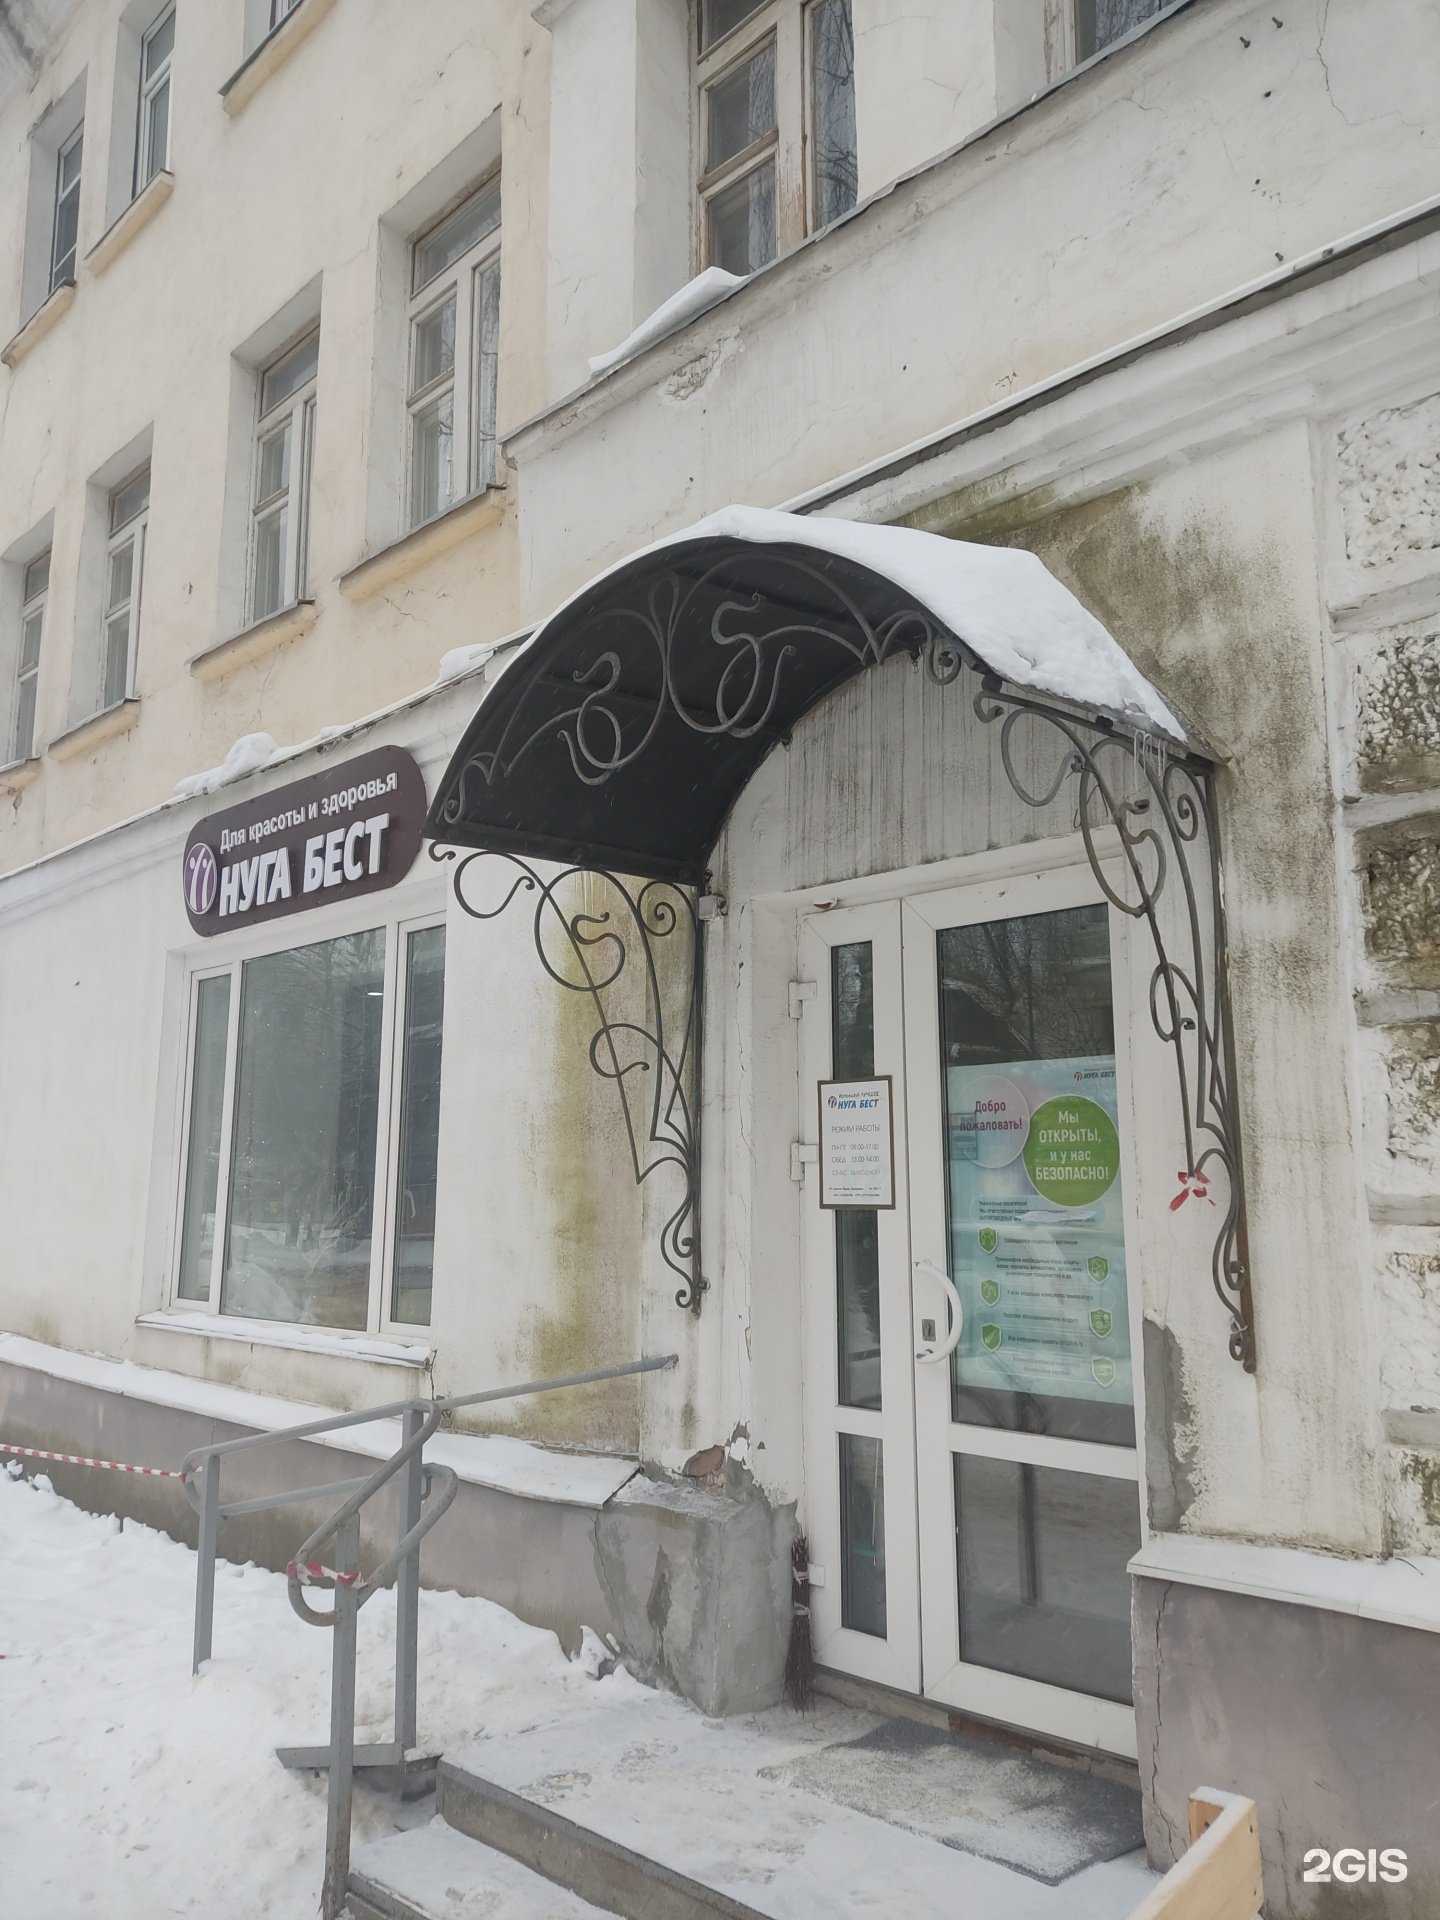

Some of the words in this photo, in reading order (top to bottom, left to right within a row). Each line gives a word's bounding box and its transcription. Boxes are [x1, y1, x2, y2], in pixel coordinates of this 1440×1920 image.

[219, 828, 246, 854] Для
[248, 806, 305, 844] красоты
[308, 803, 318, 820] и
[320, 772, 398, 814] здоровья
[218, 846, 292, 916] НУГА
[303, 813, 390, 894] БЕСТ
[837, 1099, 857, 1110] НУГА
[859, 1098, 880, 1109] БЕСТ
[975, 1101, 1006, 1114] Добро
[960, 1117, 1023, 1131] пожаловать!
[1058, 1111, 1079, 1123] Мы
[1039, 1129, 1102, 1144] ОТКРЫТЫ,
[1049, 1151, 1059, 1162] и
[1061, 1151, 1069, 1164] у
[1071, 1150, 1091, 1161] нас
[1035, 1166, 1109, 1181] БЕЗОПАСНО!
